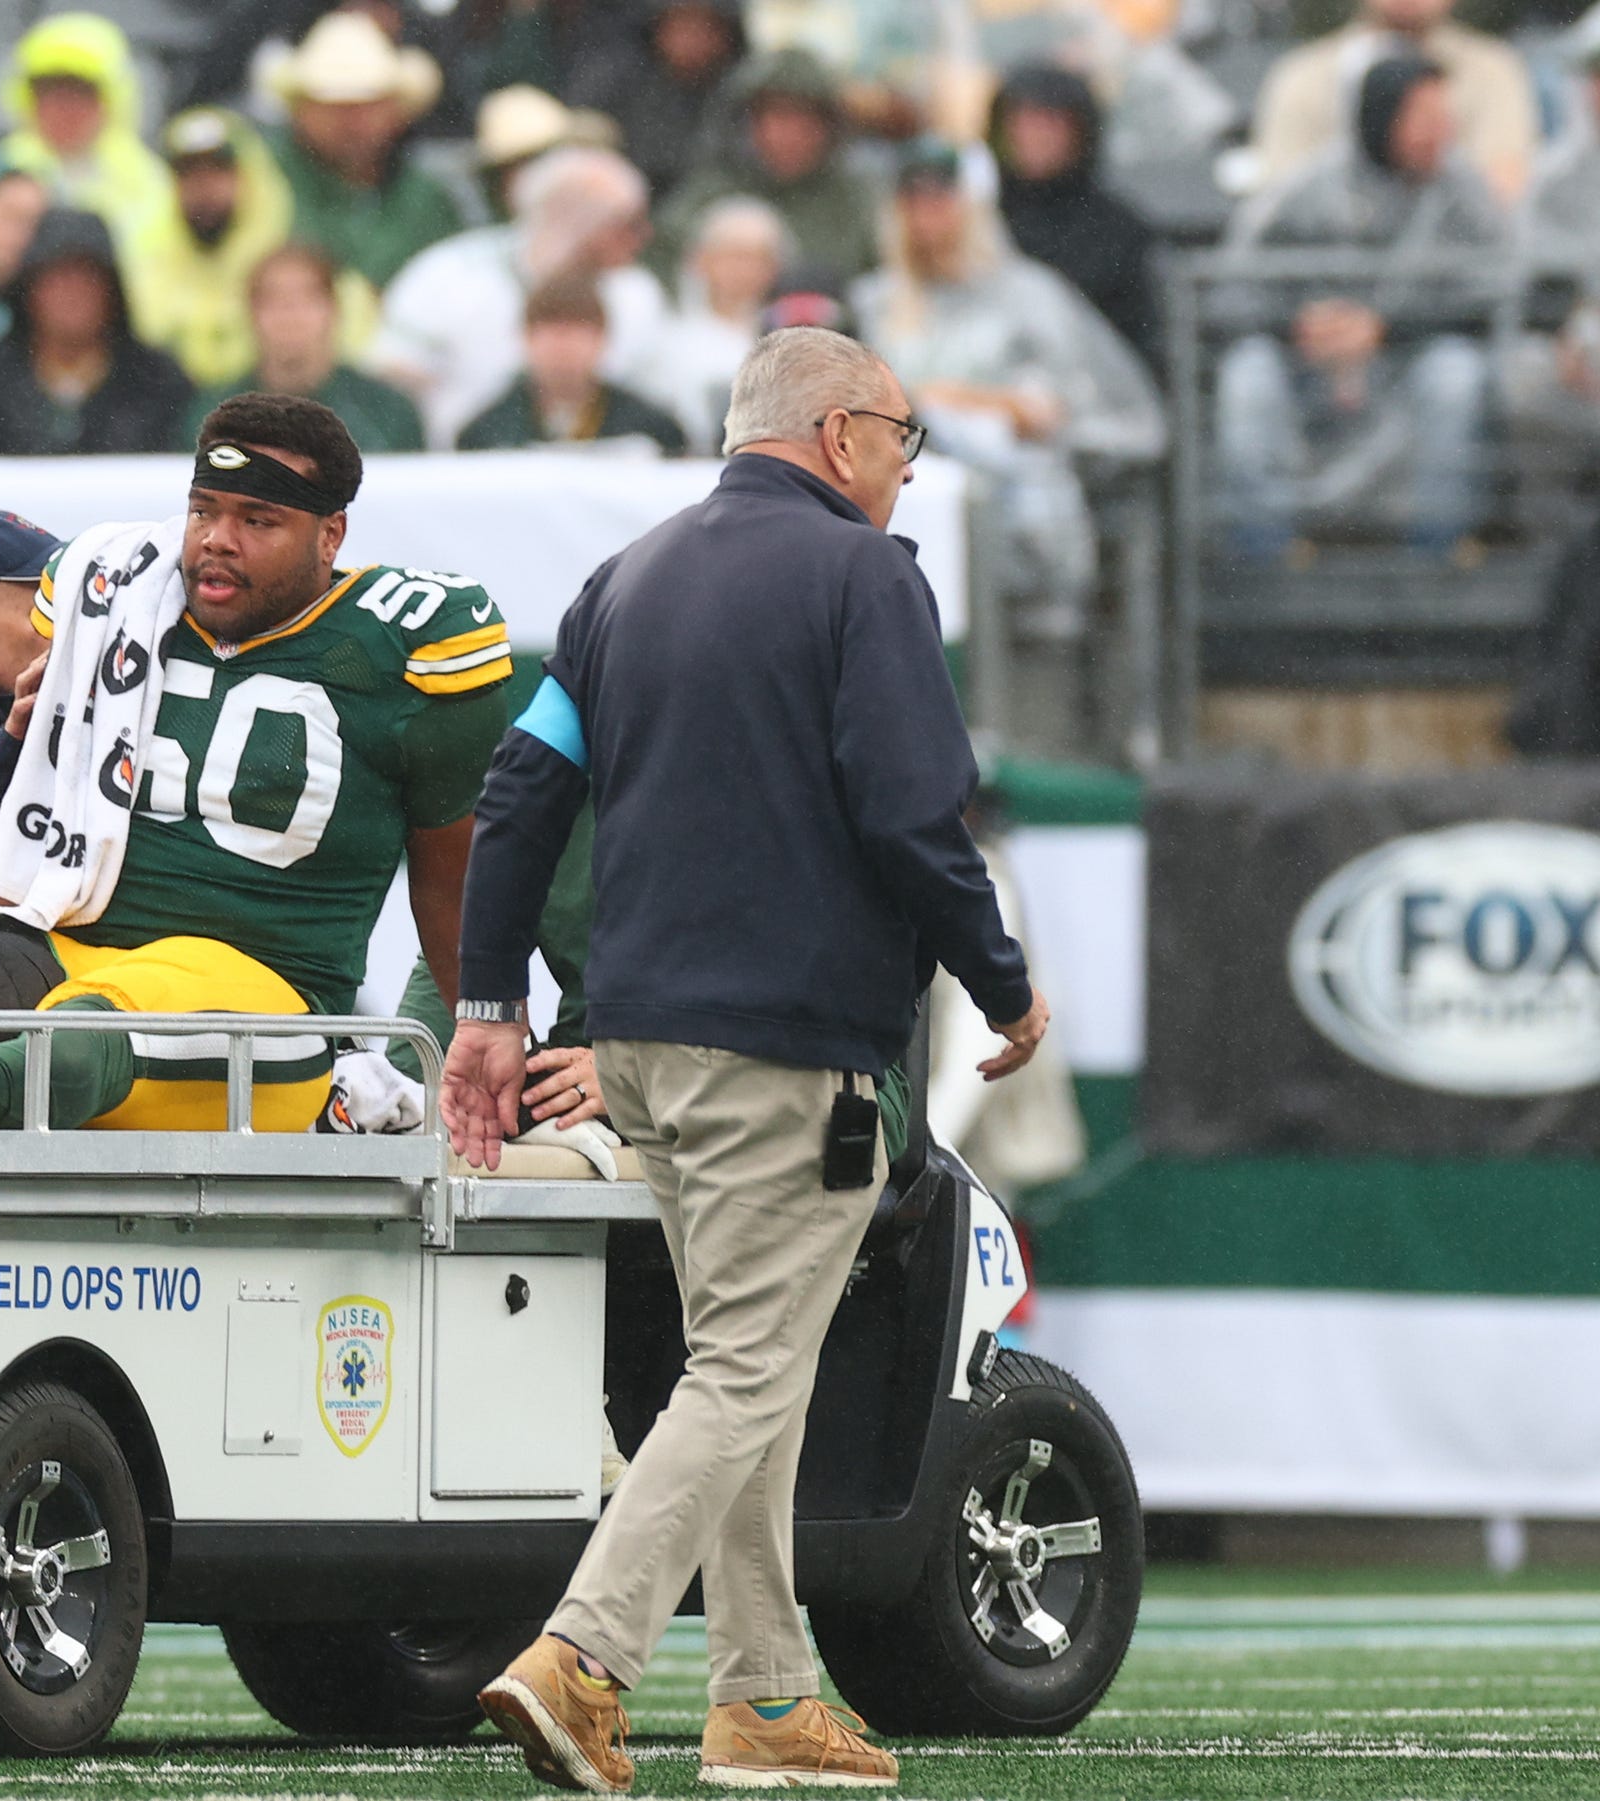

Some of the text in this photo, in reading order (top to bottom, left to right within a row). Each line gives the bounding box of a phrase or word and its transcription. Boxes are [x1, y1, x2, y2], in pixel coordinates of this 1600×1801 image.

[136, 657, 342, 870] 50
[1398, 888, 1600, 977] FOX
[974, 1227, 1014, 1287] F2
[62, 1265, 124, 1311] OPS
[133, 1266, 201, 1312] TWO
[327, 1307, 381, 1331] NJSEA
[349, 1328, 384, 1341] DEPARTMENT
[336, 1410, 370, 1418] EMERGENCY
[340, 1419, 365, 1427] MEDICAL
[339, 1428, 367, 1436] SERVICES
